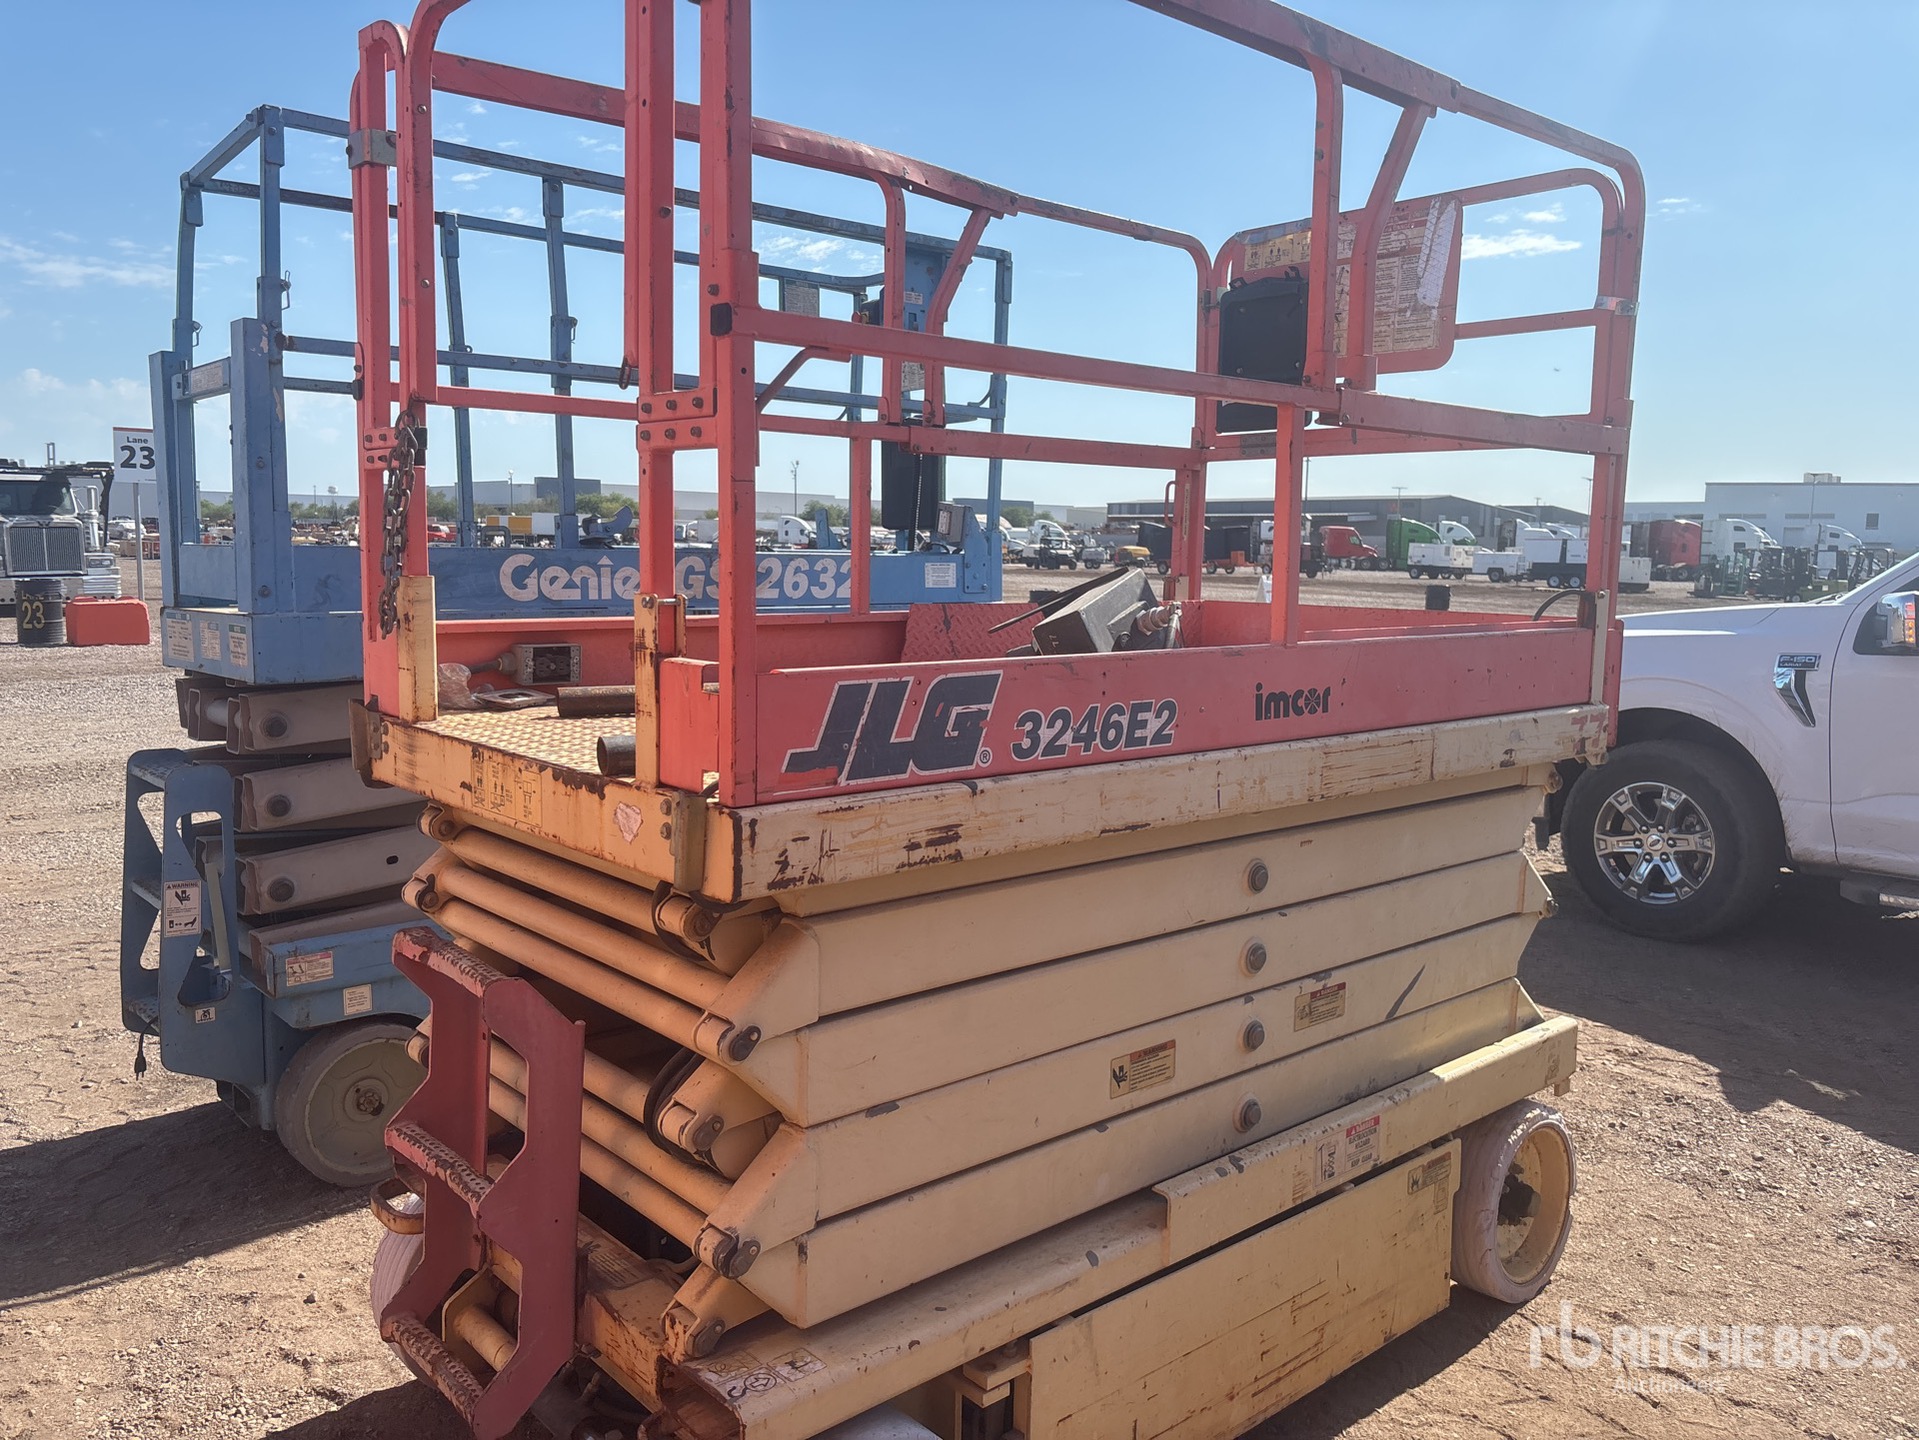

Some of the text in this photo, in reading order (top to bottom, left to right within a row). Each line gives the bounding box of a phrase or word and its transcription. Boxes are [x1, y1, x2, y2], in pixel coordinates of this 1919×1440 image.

[126, 436, 149, 444] Lane
[120, 445, 155, 470] 23
[500, 553, 639, 602] Genie
[22, 601, 45, 629] 23
[1780, 655, 1816, 663] F-150
[1255, 682, 1331, 721] imcor
[1010, 698, 1179, 763] 3246E2
